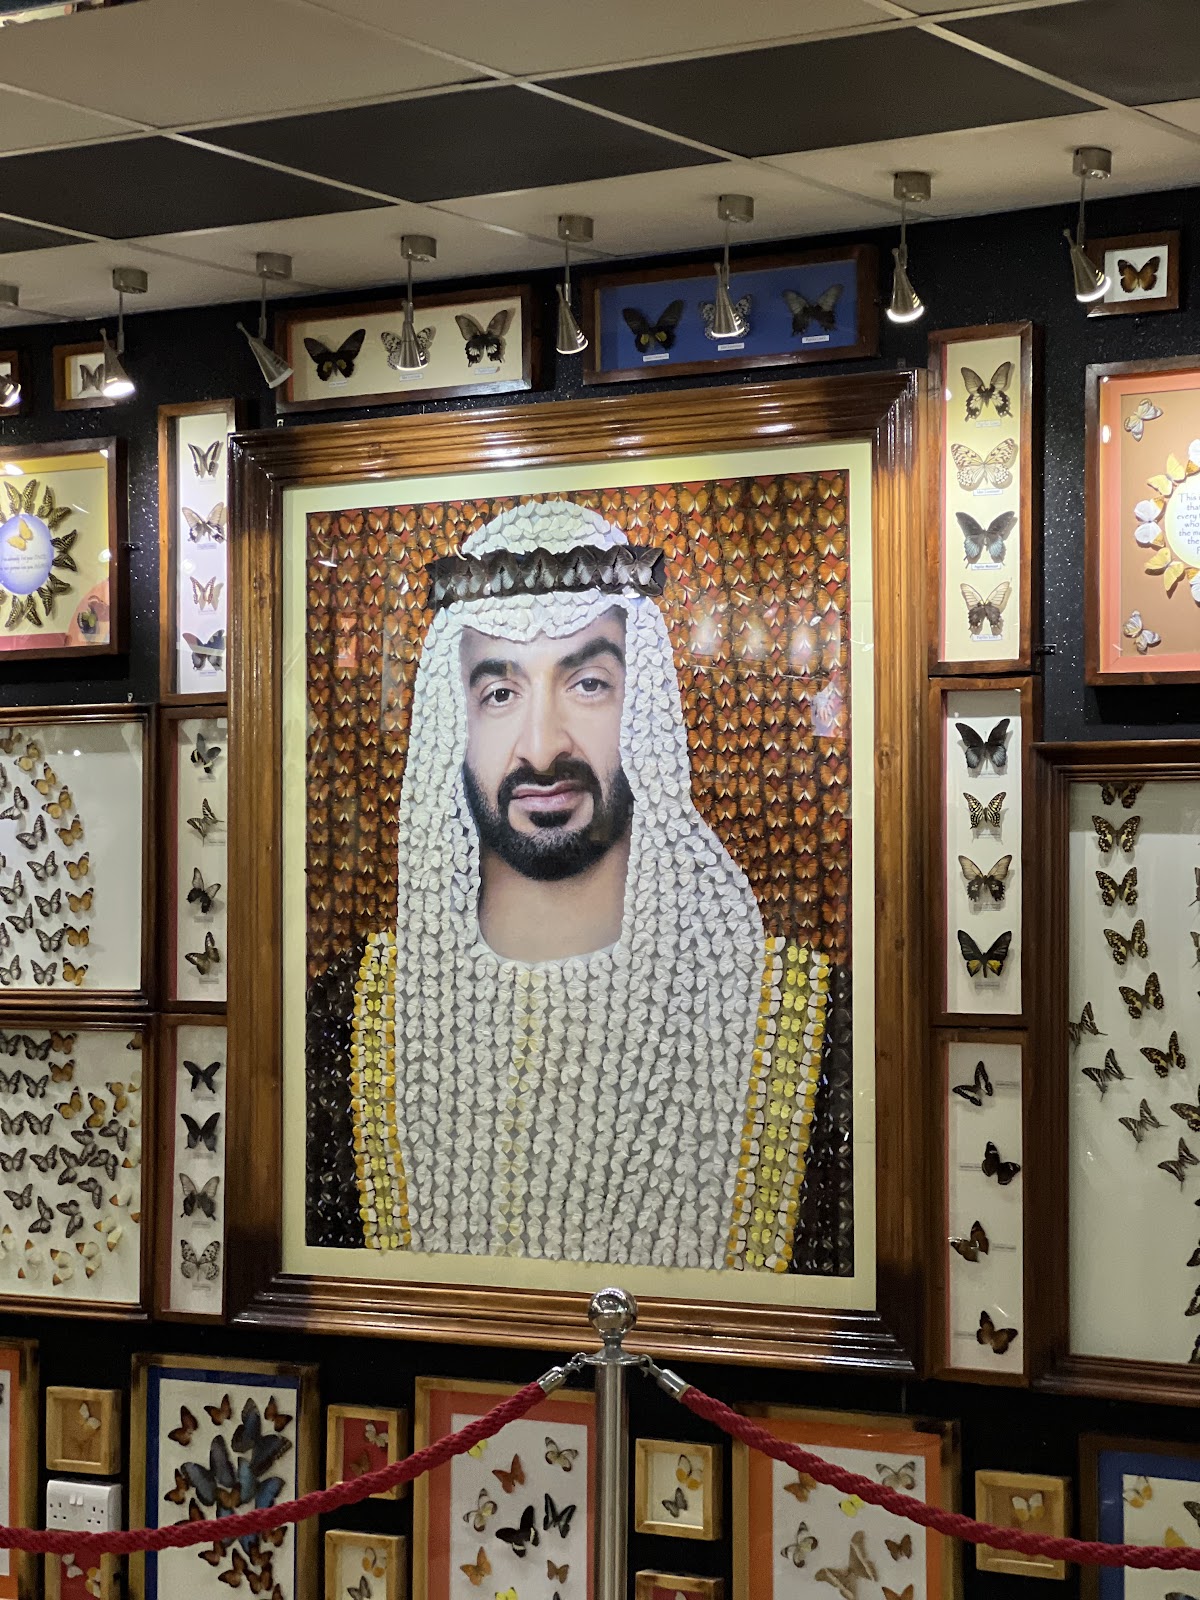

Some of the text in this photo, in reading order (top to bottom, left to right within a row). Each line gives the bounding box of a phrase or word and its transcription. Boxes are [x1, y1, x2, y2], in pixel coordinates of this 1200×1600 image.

[1178, 492, 1197, 503] This
[1177, 513, 1197, 523] every
[1179, 528, 1191, 536] the
[1188, 536, 1199, 545] the
